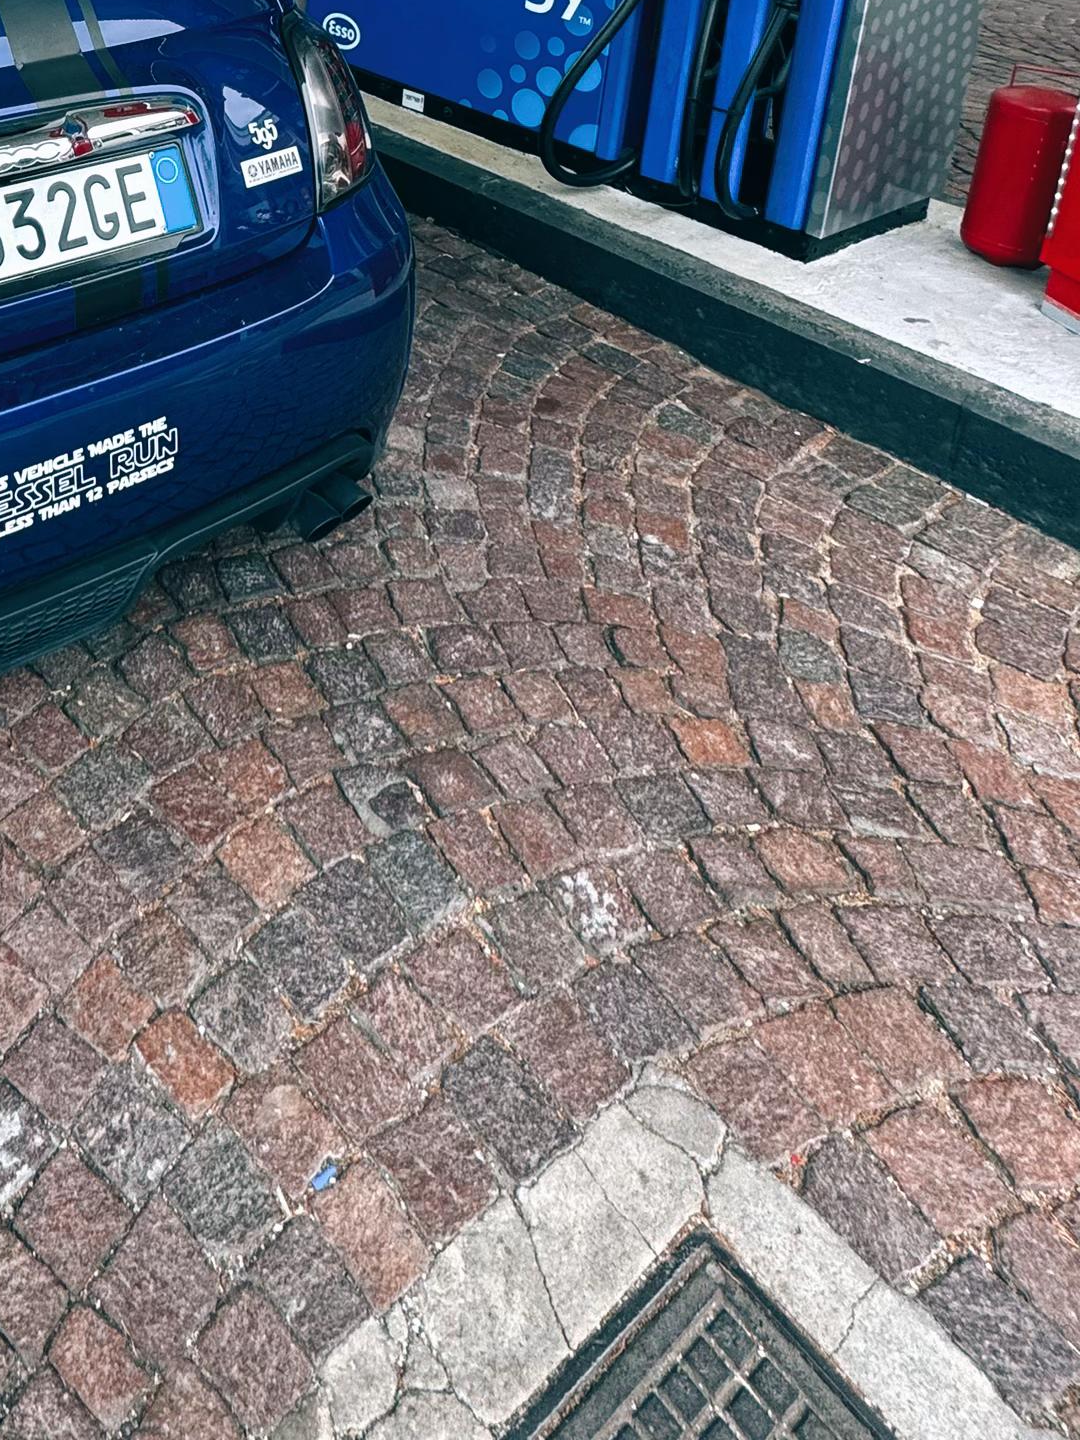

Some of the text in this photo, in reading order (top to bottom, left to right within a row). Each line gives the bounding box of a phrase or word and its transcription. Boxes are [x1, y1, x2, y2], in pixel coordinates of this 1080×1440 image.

[248, 118, 279, 150] 595
[258, 151, 299, 175] YAMAHA
[14, 447, 85, 485] VEHICLE
[87, 429, 135, 458] MADE
[138, 416, 168, 438] THE
[109, 427, 178, 478] RUN
[37, 495, 81, 521] THAN
[86, 486, 103, 503] 12
[106, 457, 175, 495] PARSECS
